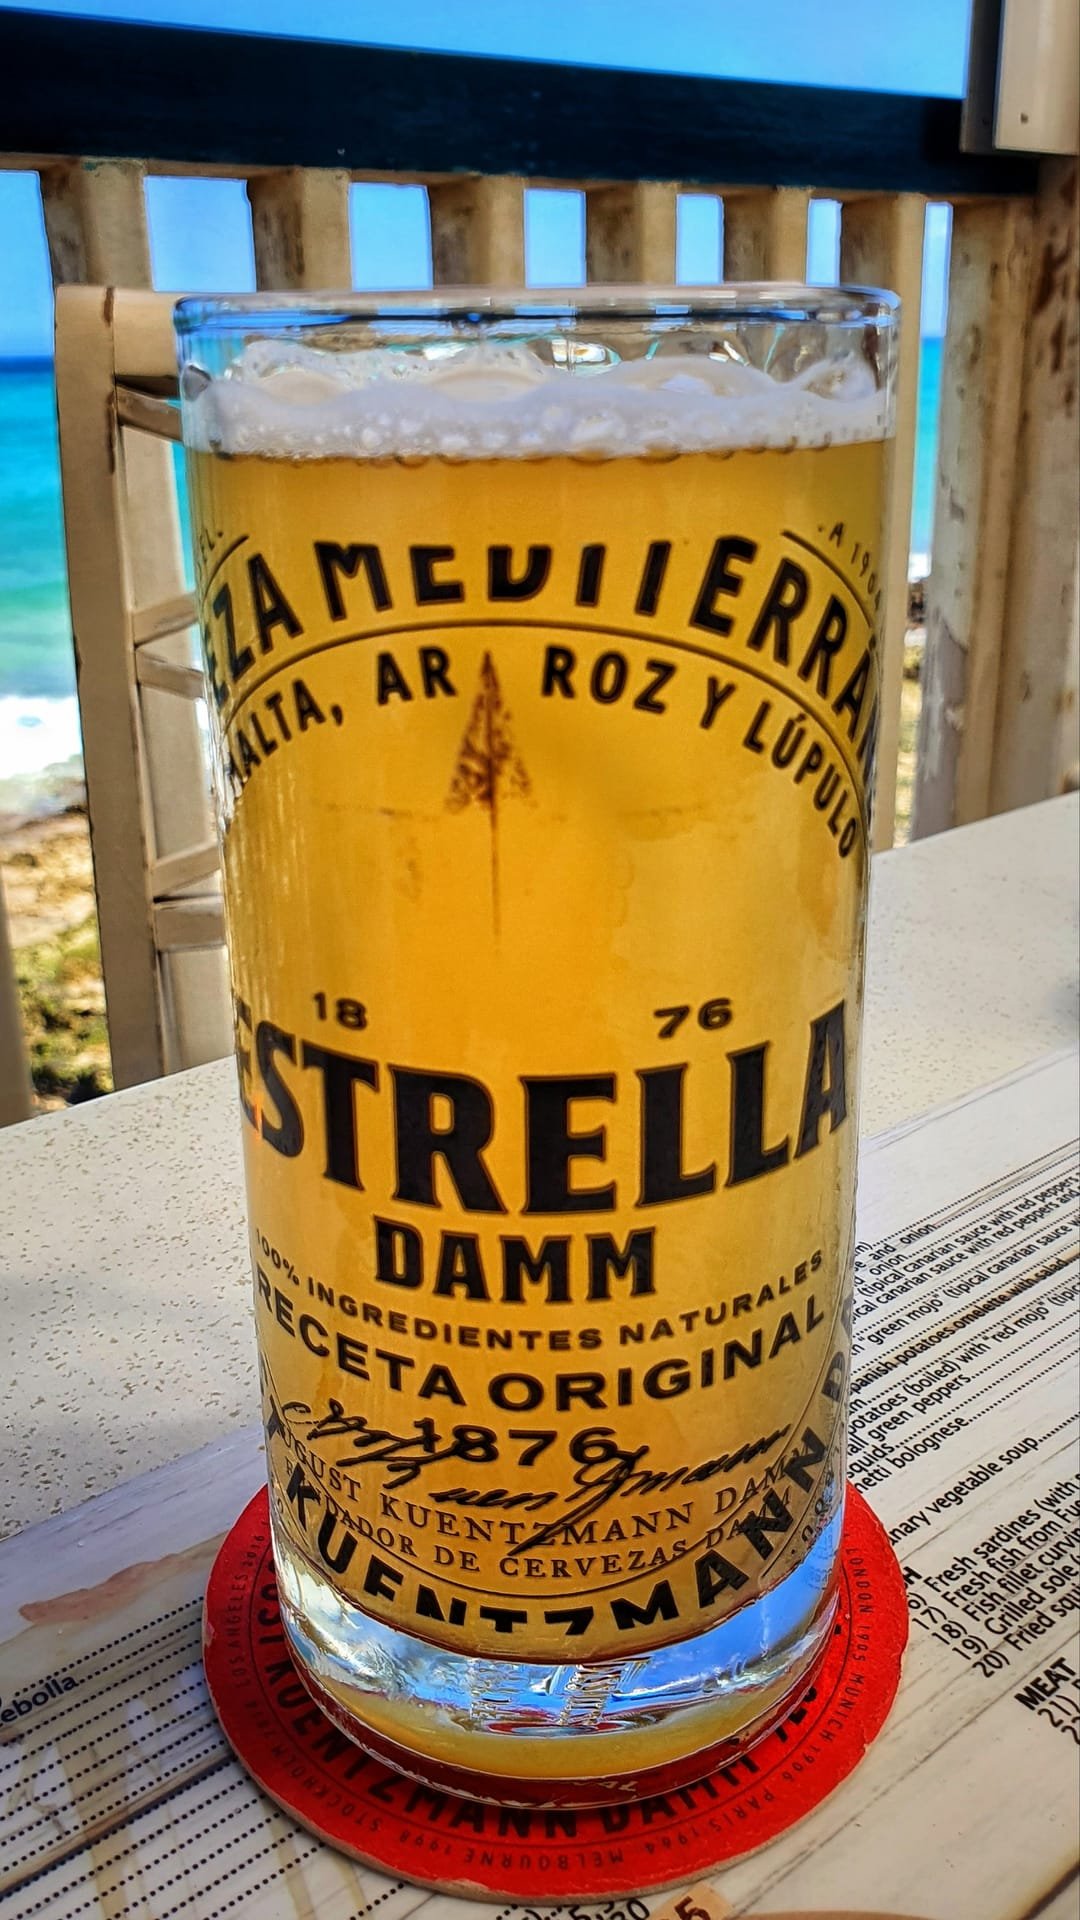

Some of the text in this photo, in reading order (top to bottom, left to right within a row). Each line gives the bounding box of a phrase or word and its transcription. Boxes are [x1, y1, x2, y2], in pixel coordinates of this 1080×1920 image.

[222, 677, 344, 786] ALTA,
[699, 674, 737, 721] Y
[742, 699, 859, 859] LÚPULO
[312, 991, 368, 1032] 18
[653, 996, 733, 1040] 76
[372, 1213, 657, 1304] DAMM
[857, 1269, 906, 1298] (tipical
[903, 1242, 957, 1273] canarian
[954, 1223, 992, 1246] sauce
[987, 1209, 1018, 1227] with
[1014, 1197, 1037, 1213] red
[1033, 1176, 1079, 1203] peppers
[868, 1243, 897, 1260] and
[899, 1223, 937, 1245] onion
[869, 1254, 909, 1276] onion
[876, 1271, 933, 1304] canarian
[929, 1252, 968, 1275] sauce
[963, 1237, 996, 1255] with
[992, 1224, 1016, 1241] red
[1012, 1201, 1060, 1231] peppers
[942, 1269, 991, 1299] (tipical
[987, 1242, 1040, 1274] canarian
[1036, 1224, 1073, 1247] sauce
[255, 1228, 823, 1351] 100% INGREDIENTES NATURALES
[256, 1262, 467, 1407] RECETA
[488, 1294, 825, 1412] ORIGINAL
[849, 1360, 899, 1395] panish
[894, 1326, 957, 1366] potatoes
[952, 1293, 1011, 1330] omelette
[1006, 1276, 1038, 1297] with
[902, 1359, 962, 1397] (boiled)
[956, 1342, 991, 1365] with
[414, 1417, 620, 1467] 1876
[867, 1408, 915, 1442] green
[911, 1373, 972, 1415] peppers
[885, 1416, 970, 1469] bolognese
[846, 1442, 896, 1479] squids
[924, 1460, 1004, 1515] vegetable
[998, 1435, 1040, 1465] soup
[433, 1544, 490, 1573] DE
[499, 1540, 688, 1578] CERVEZAS
[912, 1606, 948, 1631] 17)
[941, 1570, 996, 1609] Fresh
[985, 1548, 1027, 1574] fish
[1017, 1520, 1064, 1551] from
[922, 1555, 978, 1593] Fresh
[972, 1508, 1042, 1560] sardines
[223, 1572, 248, 1649] ANGELES
[931, 1619, 968, 1646] 18)
[961, 1591, 1007, 1623] Fish
[996, 1562, 1045, 1595] fillet
[952, 1564, 1079, 1661] 19) Grilled sole
[972, 1650, 1011, 1679] 20)
[1003, 1609, 1057, 1651] Fried
[820, 1672, 865, 1743] MUNICH
[1014, 1657, 1077, 1712] MEAT
[708, 1787, 776, 1833] PARIS
[464, 1847, 625, 1872] MELBOURNE
